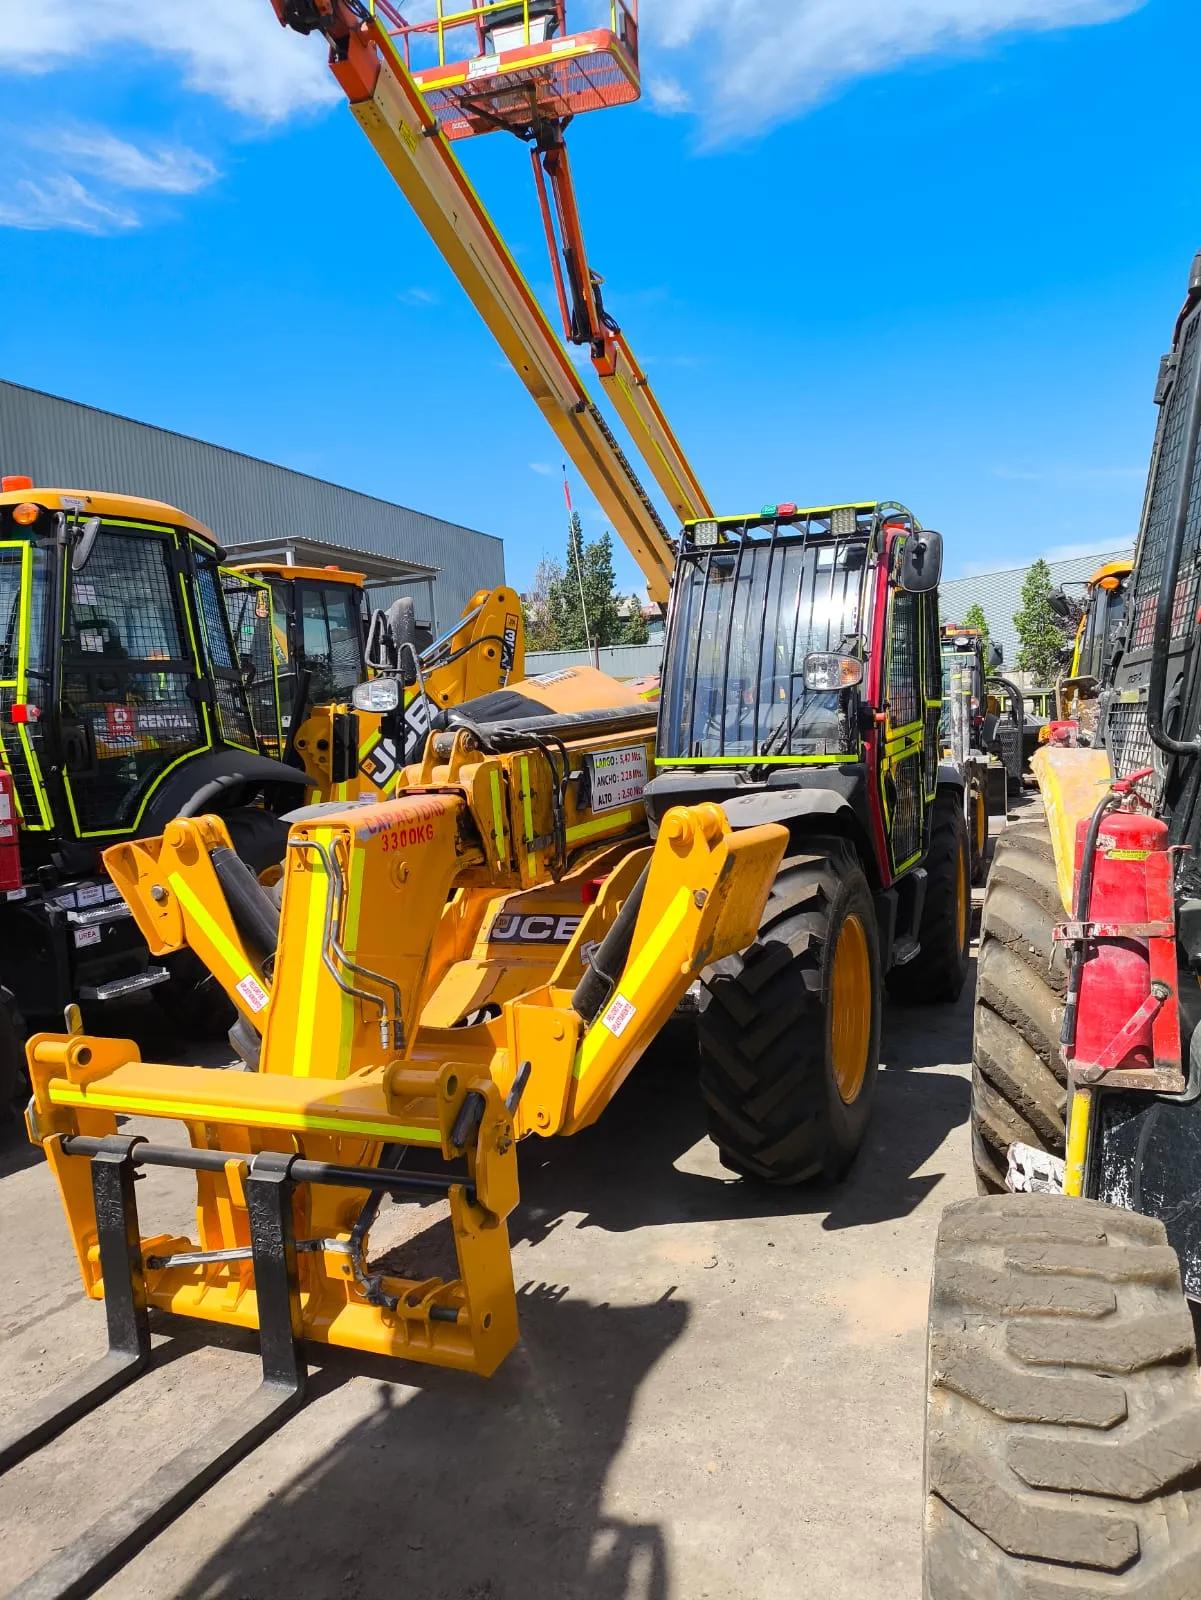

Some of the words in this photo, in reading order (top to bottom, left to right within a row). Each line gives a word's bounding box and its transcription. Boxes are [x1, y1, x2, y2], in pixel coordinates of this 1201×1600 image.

[138, 714, 192, 728] RENTAL
[381, 824, 434, 852] 3300KG
[78, 930, 97, 940] UREA
